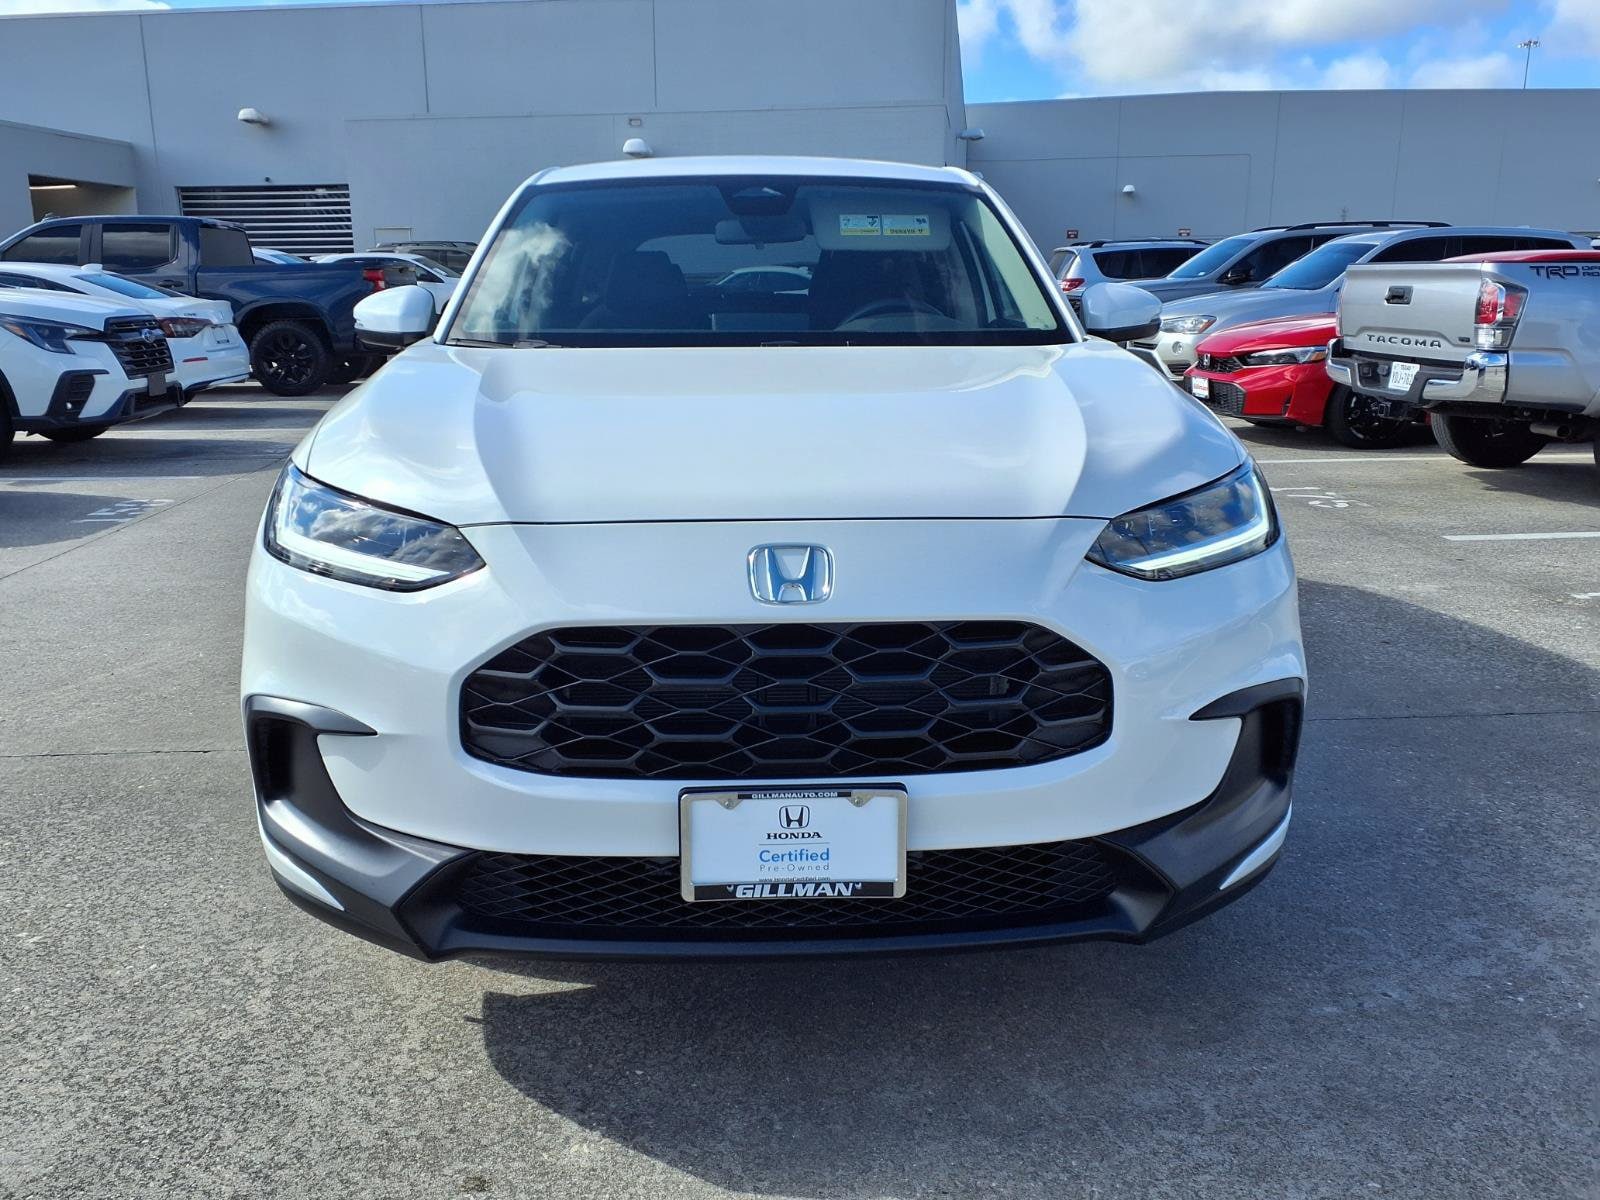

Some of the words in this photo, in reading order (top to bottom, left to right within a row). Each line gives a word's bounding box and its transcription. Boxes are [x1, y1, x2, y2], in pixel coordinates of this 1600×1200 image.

[1529, 265, 1580, 279] TRD
[1367, 334, 1442, 348] TACOMA
[751, 791, 838, 799] GILLMANAUTO.COM
[759, 848, 830, 862] Certified
[759, 863, 830, 872] Pre-Owned
[735, 882, 853, 898] GILLMAN
